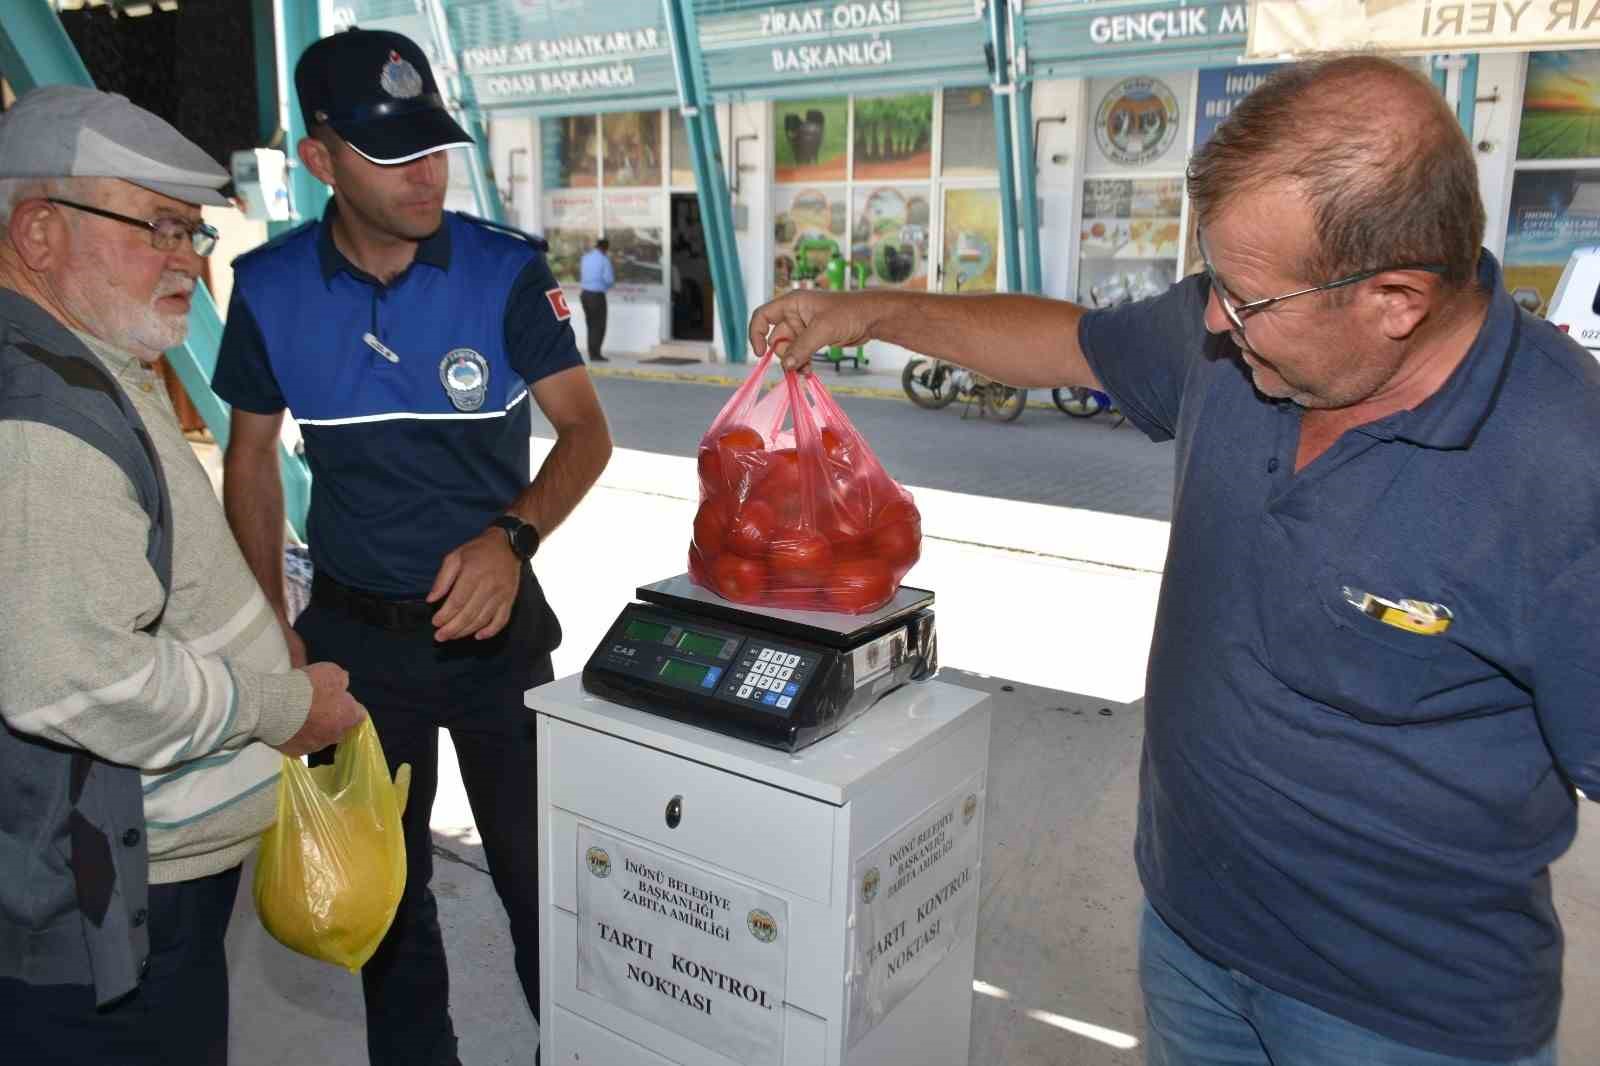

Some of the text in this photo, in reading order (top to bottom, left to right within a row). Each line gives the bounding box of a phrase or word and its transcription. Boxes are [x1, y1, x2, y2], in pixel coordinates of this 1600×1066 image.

[760, 0, 900, 35] ZİRAAT ODASI
[1089, 0, 1248, 43] GENÇLİK M
[771, 32, 892, 73] BAŞKANLIĞI
[622, 888, 668, 915] ZABITA
[624, 857, 731, 911] İNÖNÜ BELEDİYE
[597, 922, 772, 1011] TARTI KONTROL
[626, 963, 713, 1015] NOKTASI
